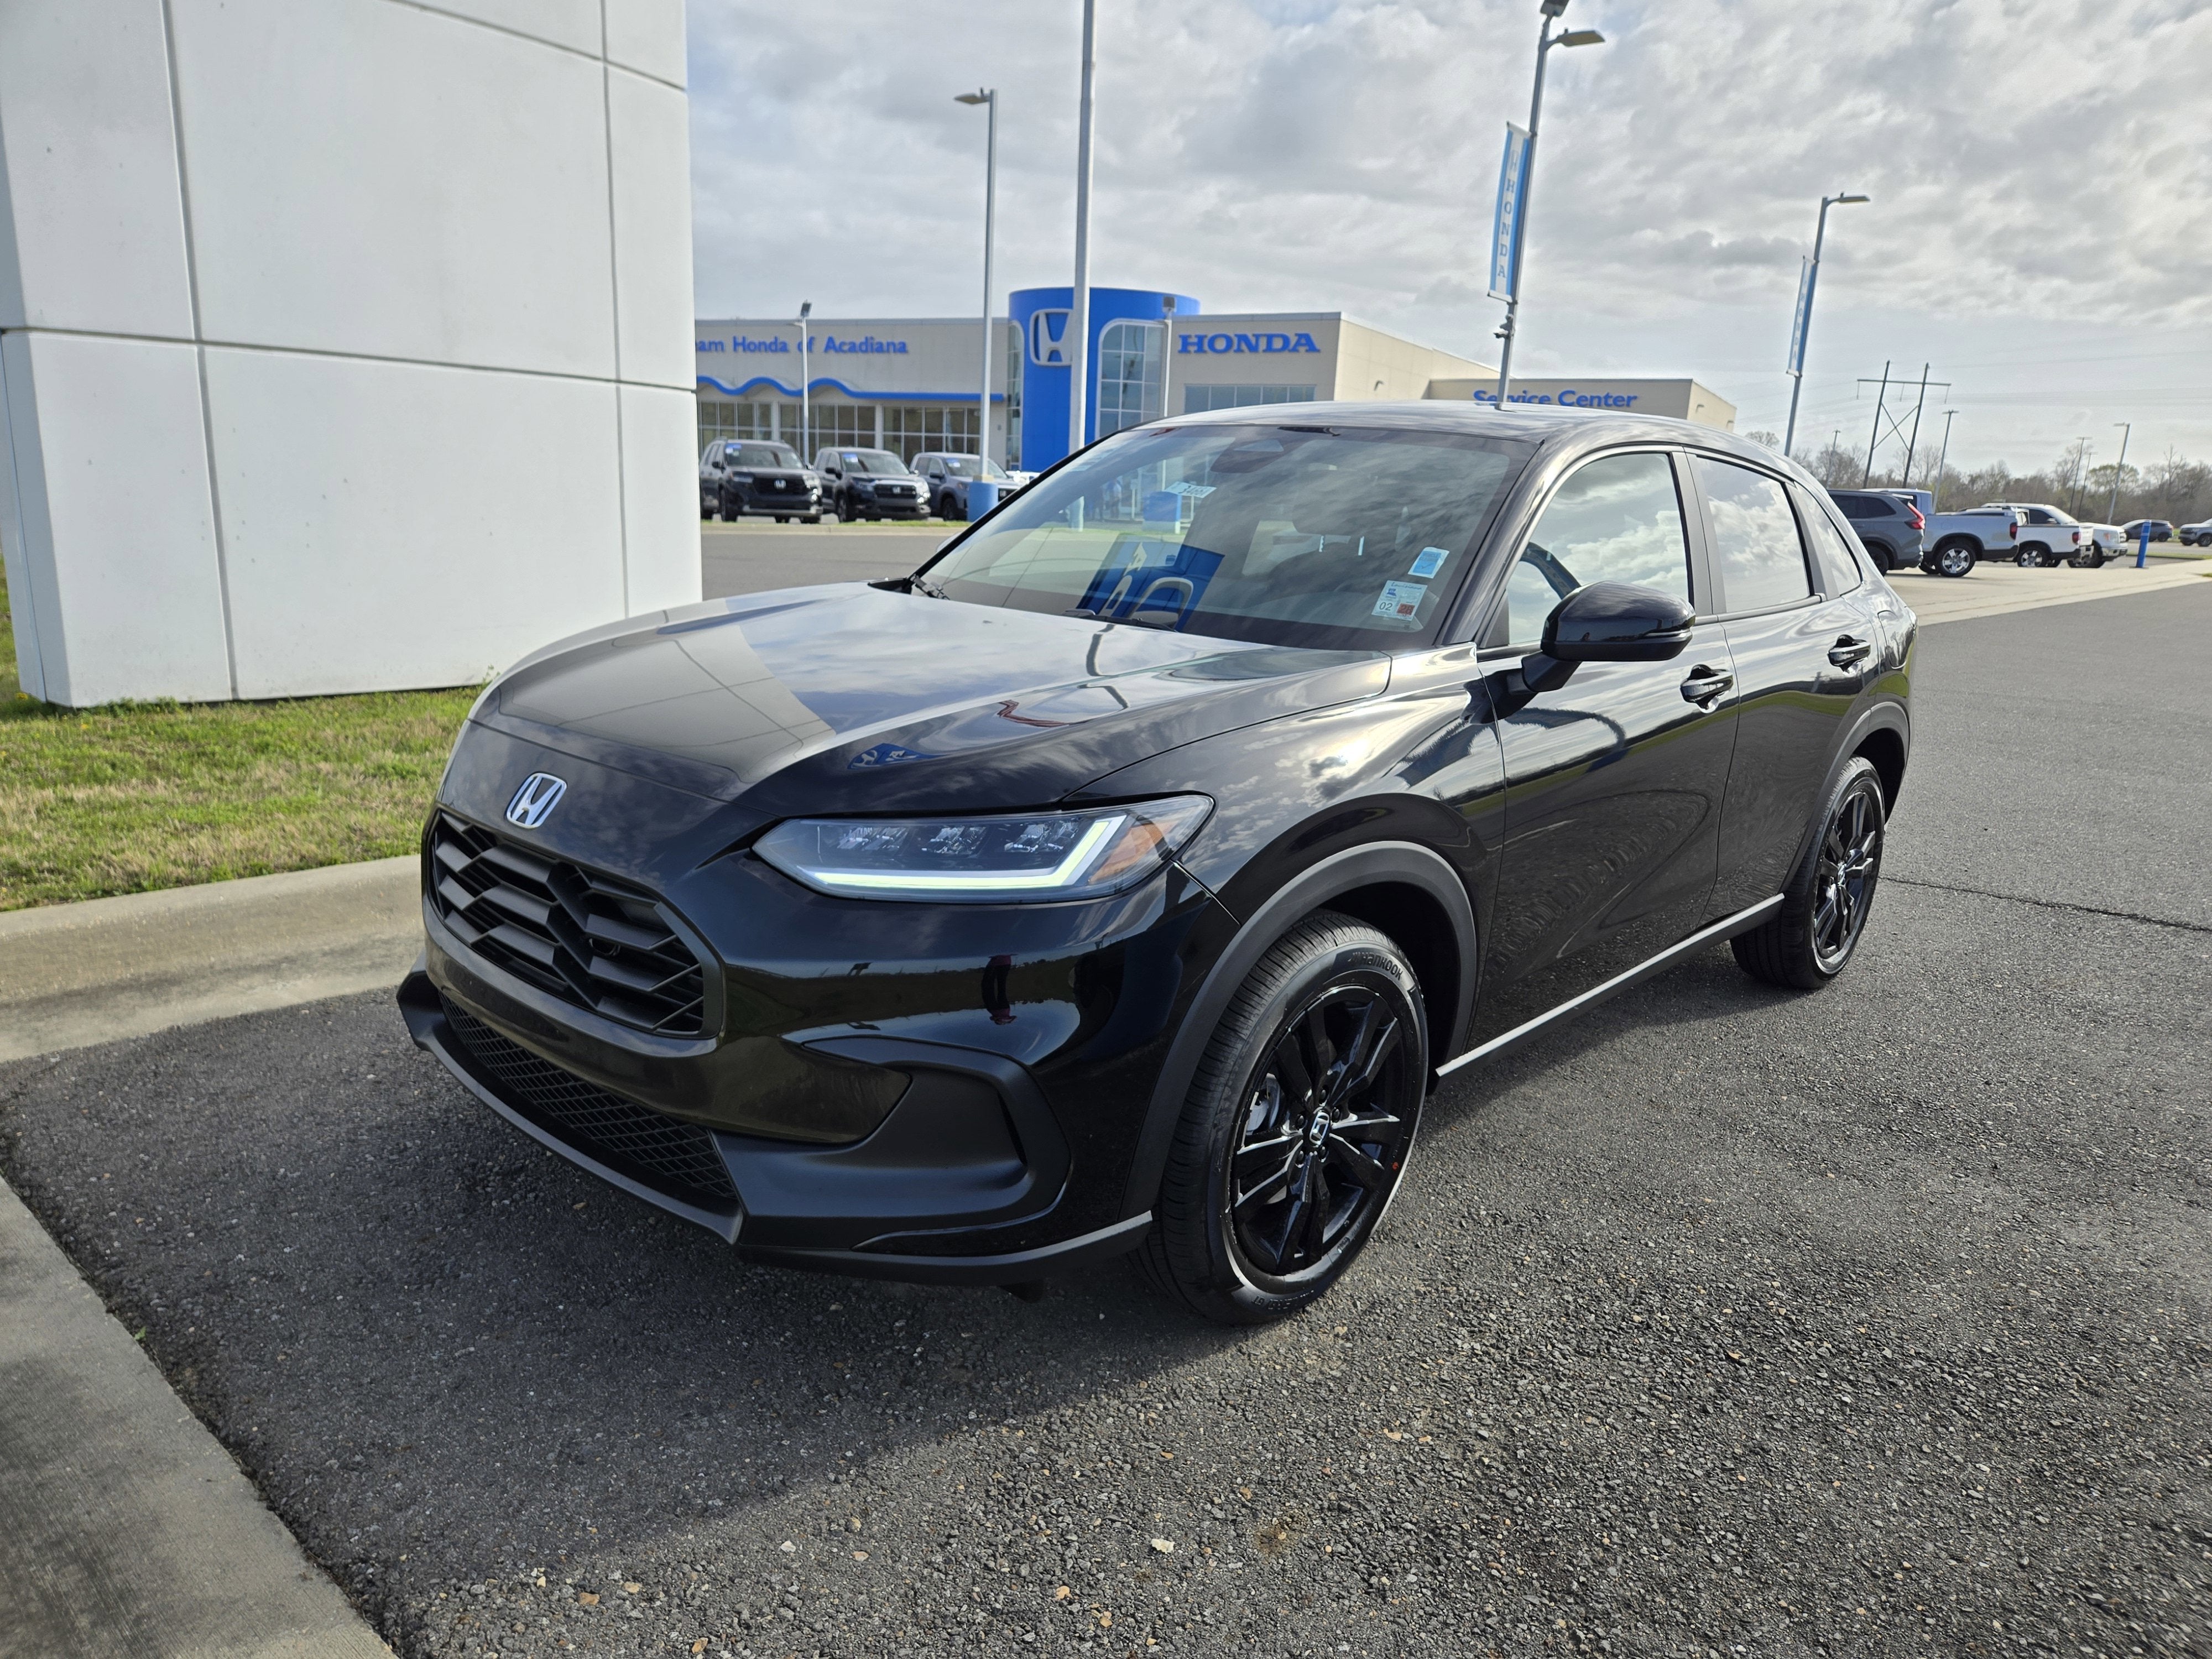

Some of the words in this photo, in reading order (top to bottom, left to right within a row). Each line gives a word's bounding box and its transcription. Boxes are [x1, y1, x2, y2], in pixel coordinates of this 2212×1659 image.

[1498, 178, 1515, 278] HONDA
[695, 340, 724, 352] am
[733, 336, 789, 352] Honda
[824, 336, 907, 353] Acadiana
[1178, 332, 1321, 354] HONDA
[1474, 390, 1551, 404] Sevice
[1558, 390, 1637, 408] Center
[1379, 602, 1393, 611] 02
